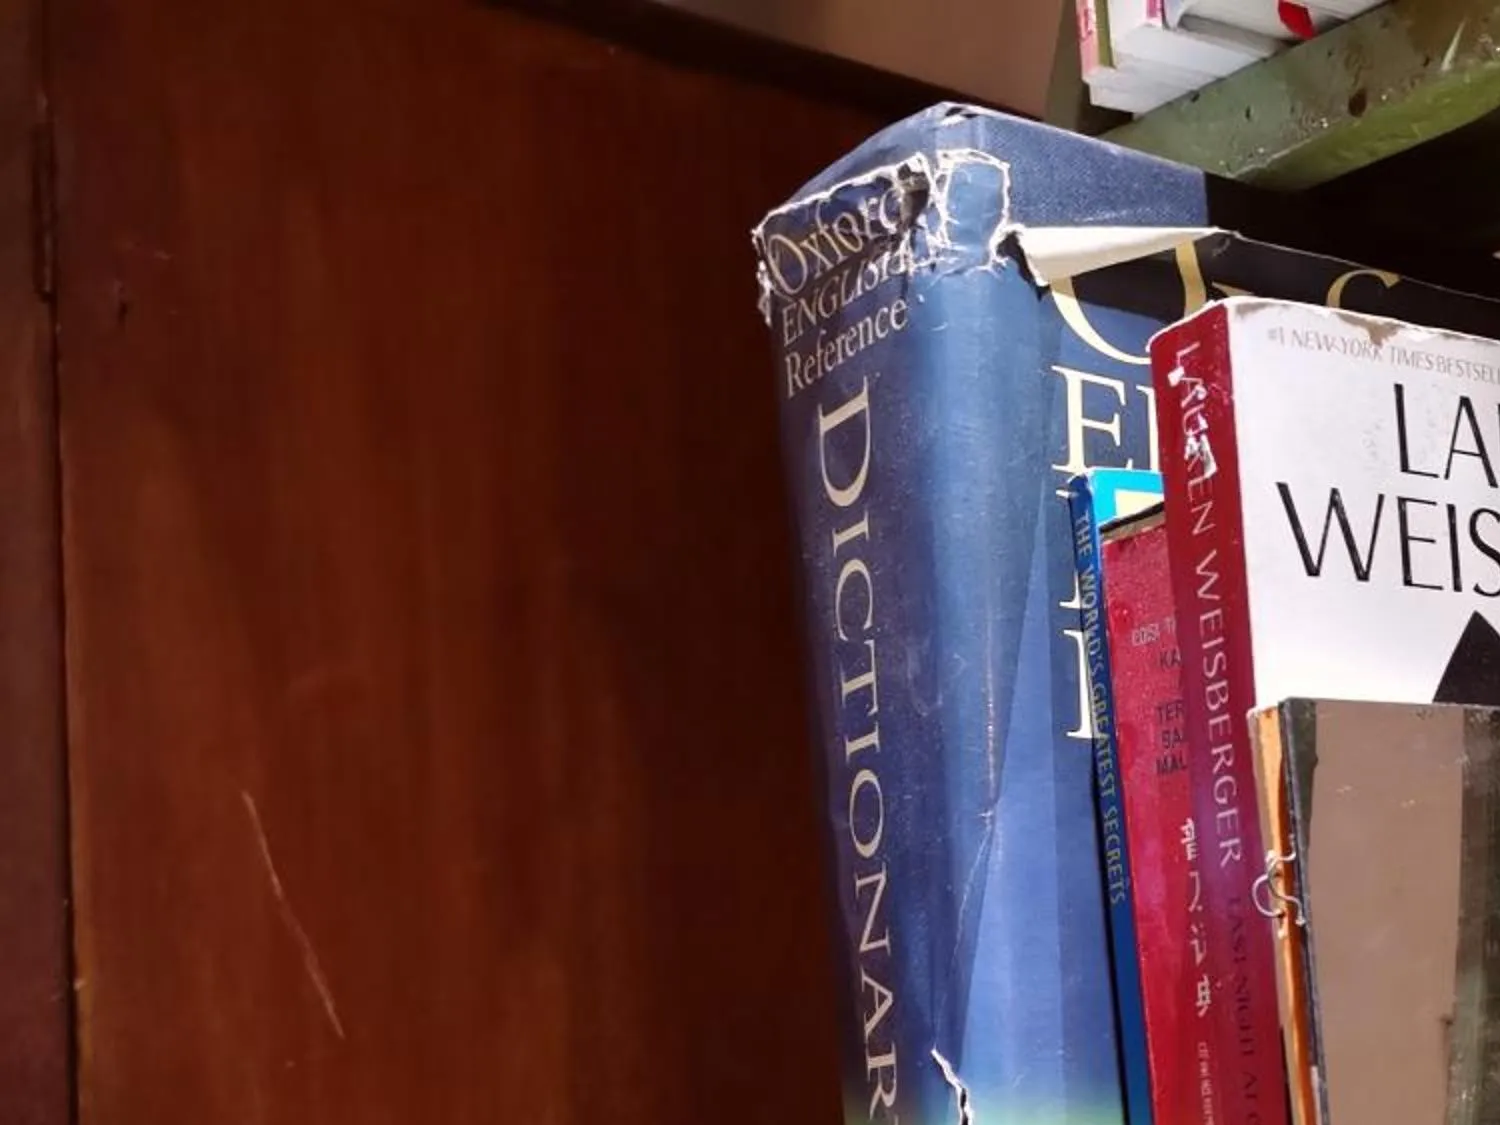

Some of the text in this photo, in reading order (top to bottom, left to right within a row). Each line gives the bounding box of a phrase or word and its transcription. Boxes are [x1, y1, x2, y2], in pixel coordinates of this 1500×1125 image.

[784, 295, 908, 399] Reference
[1389, 346, 1433, 371] TIMES
[1074, 511, 1095, 557] THE
[1080, 565, 1107, 675] WORLD'S
[1093, 681, 1117, 798] GREATEST
[1195, 551, 1243, 869] WEISBERGER
[1104, 805, 1128, 906] SECRETS
